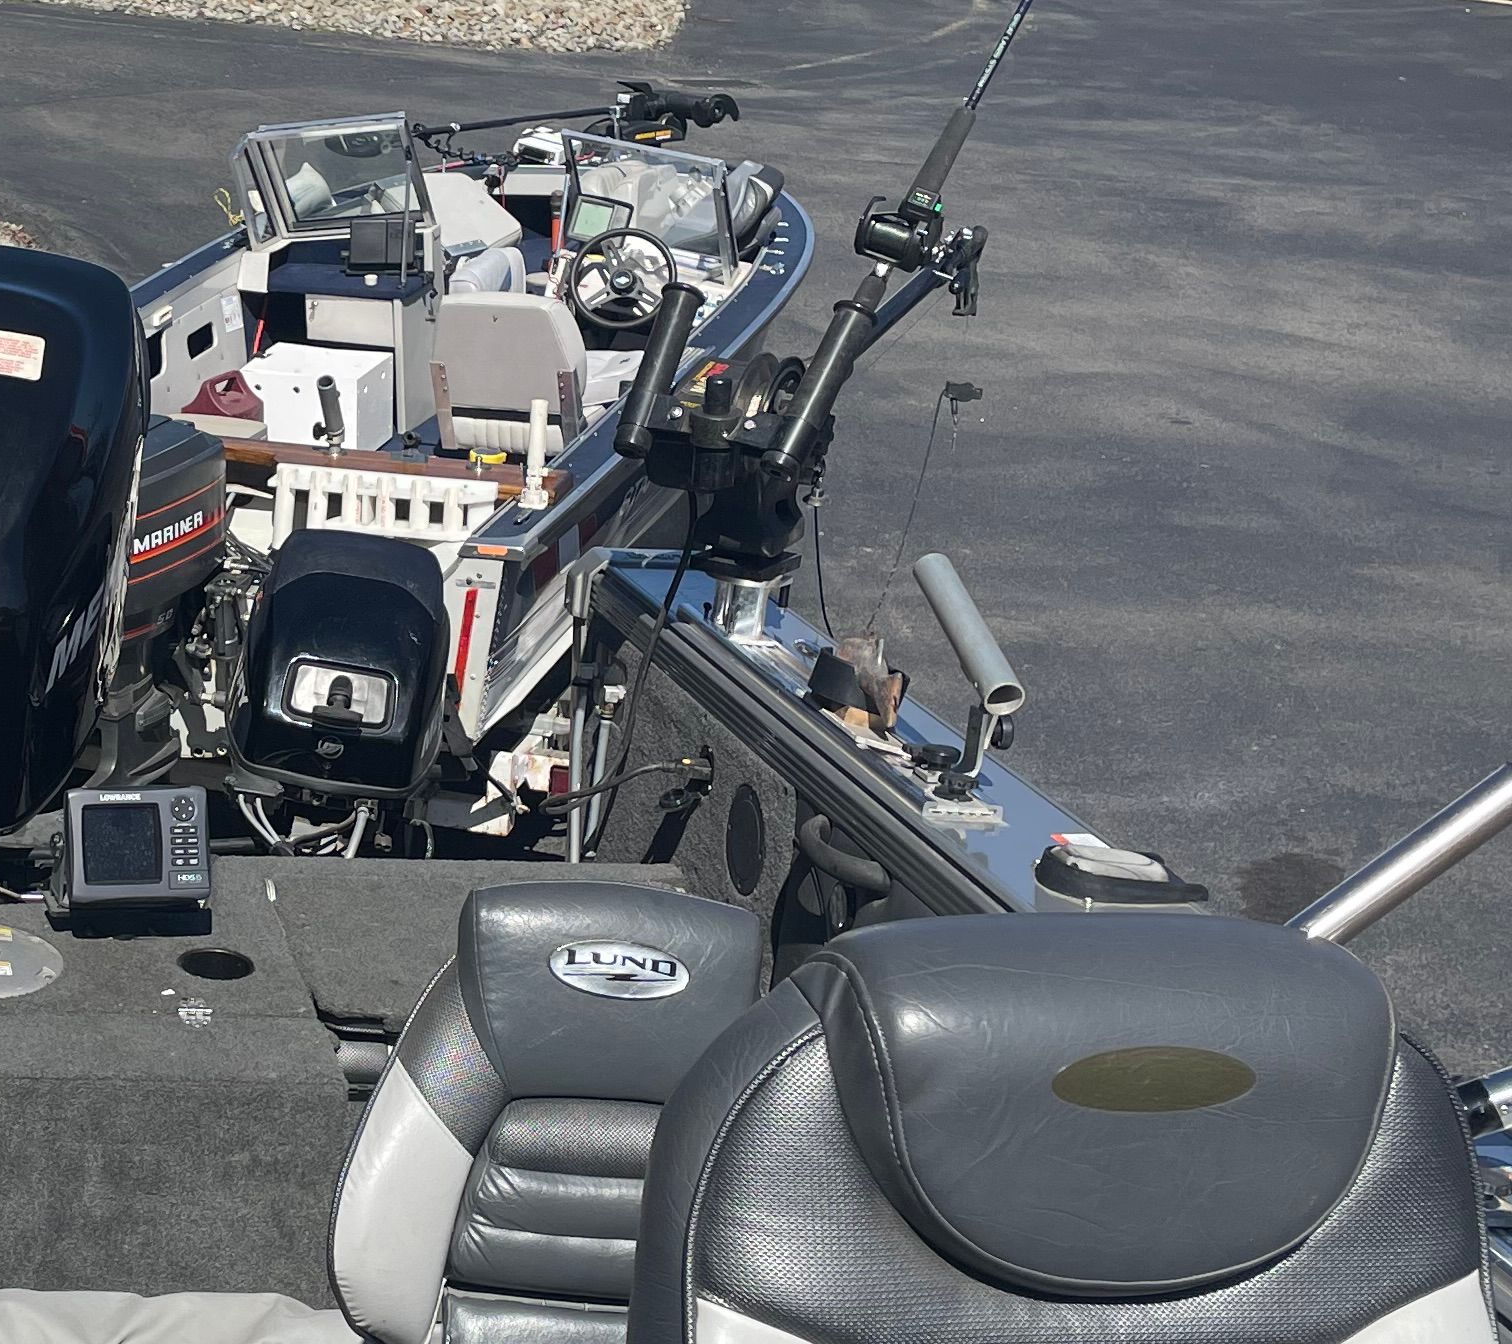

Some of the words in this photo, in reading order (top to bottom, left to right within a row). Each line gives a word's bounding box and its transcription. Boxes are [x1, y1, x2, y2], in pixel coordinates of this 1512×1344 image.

[133, 510, 204, 555] MARINER
[99, 793, 142, 802] LOWRANCE
[566, 948, 678, 978] LUND
